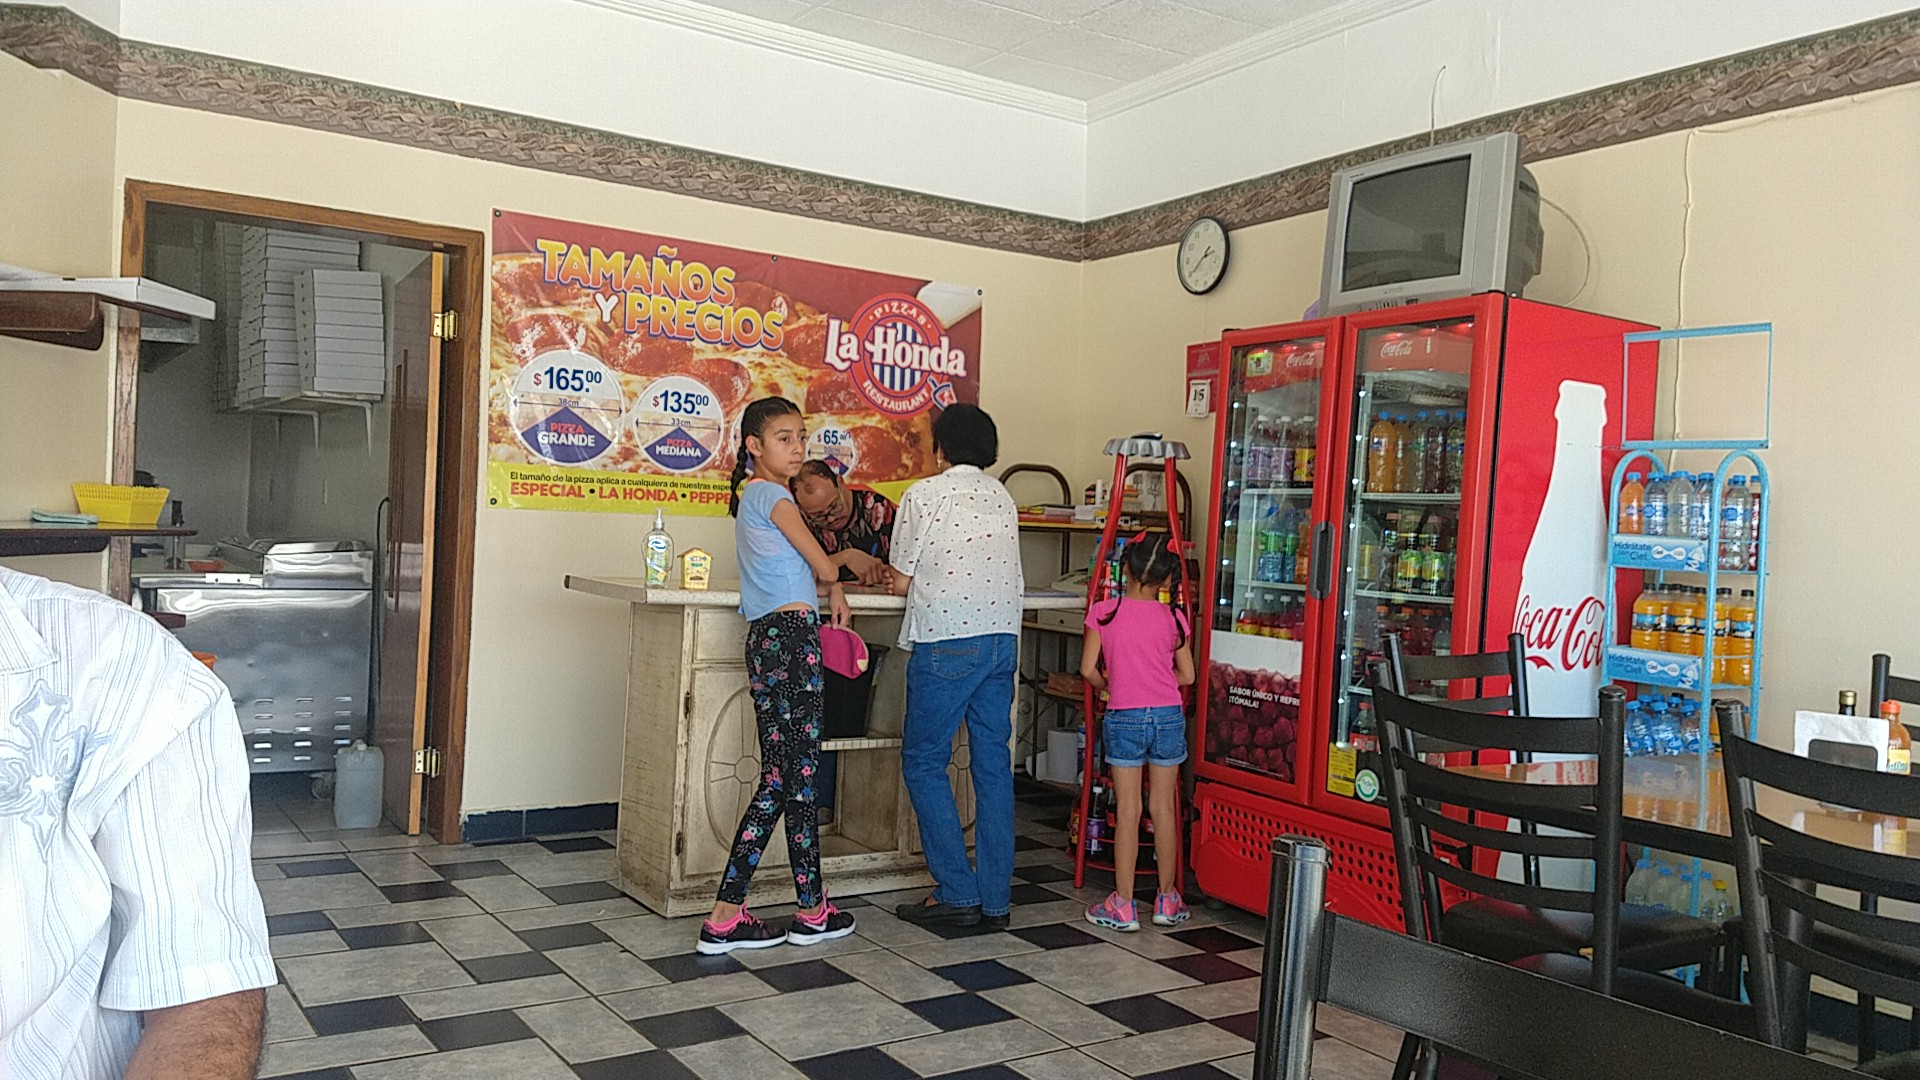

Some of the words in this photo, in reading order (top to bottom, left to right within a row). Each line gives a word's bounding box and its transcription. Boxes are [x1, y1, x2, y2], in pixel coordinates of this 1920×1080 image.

[536, 239, 735, 306] TAMAÑOS
[595, 293, 619, 323] Y
[625, 292, 784, 350] PRECIOS
[874, 302, 926, 324] PIZZAS
[824, 318, 860, 372] La
[864, 325, 967, 377] Honda
[862, 380, 930, 411] RESTAURANT
[1193, 388, 1205, 402] 15
[551, 422, 584, 434] PIZZA
[538, 431, 596, 447] GRANDE
[667, 438, 692, 447] PIZZA
[656, 445, 702, 457] MEDIANA
[510, 472, 518, 480] El
[520, 473, 551, 481] tamaño
[553, 474, 563, 482] de
[566, 475, 573, 483] la
[574, 476, 594, 484] pizza
[596, 477, 619, 486] aplica
[627, 478, 668, 488] cualquiera
[510, 482, 585, 498] ESPECIAL
[598, 486, 619, 499] LA
[622, 487, 678, 502] HONDA
[1514, 594, 1605, 671] Coca-Col
[1229, 686, 1251, 697] SABOR
[1252, 689, 1273, 702] ÚNICO
[1274, 694, 1279, 702] Y
